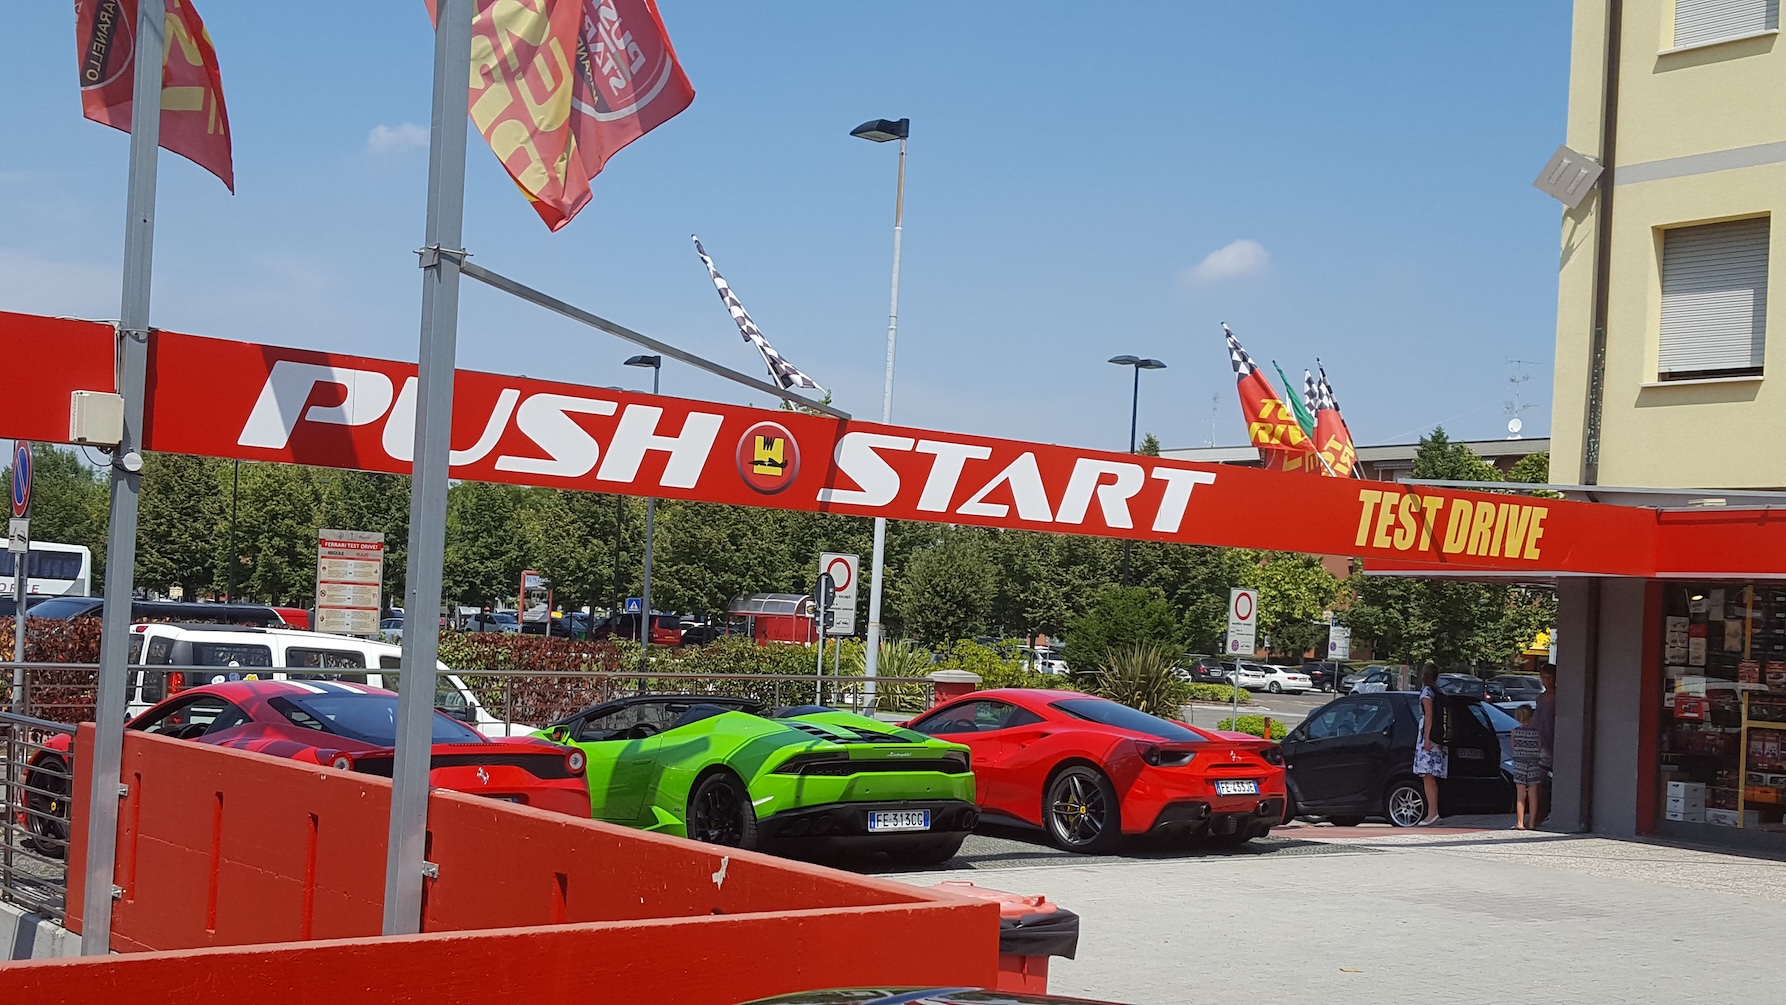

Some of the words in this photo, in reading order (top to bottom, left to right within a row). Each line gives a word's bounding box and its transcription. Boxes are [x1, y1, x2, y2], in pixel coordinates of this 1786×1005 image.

[237, 360, 724, 489] PUSH
[816, 431, 1217, 533] START
[1355, 489, 1445, 551] TEST
[1442, 498, 1549, 560] DRIVE
